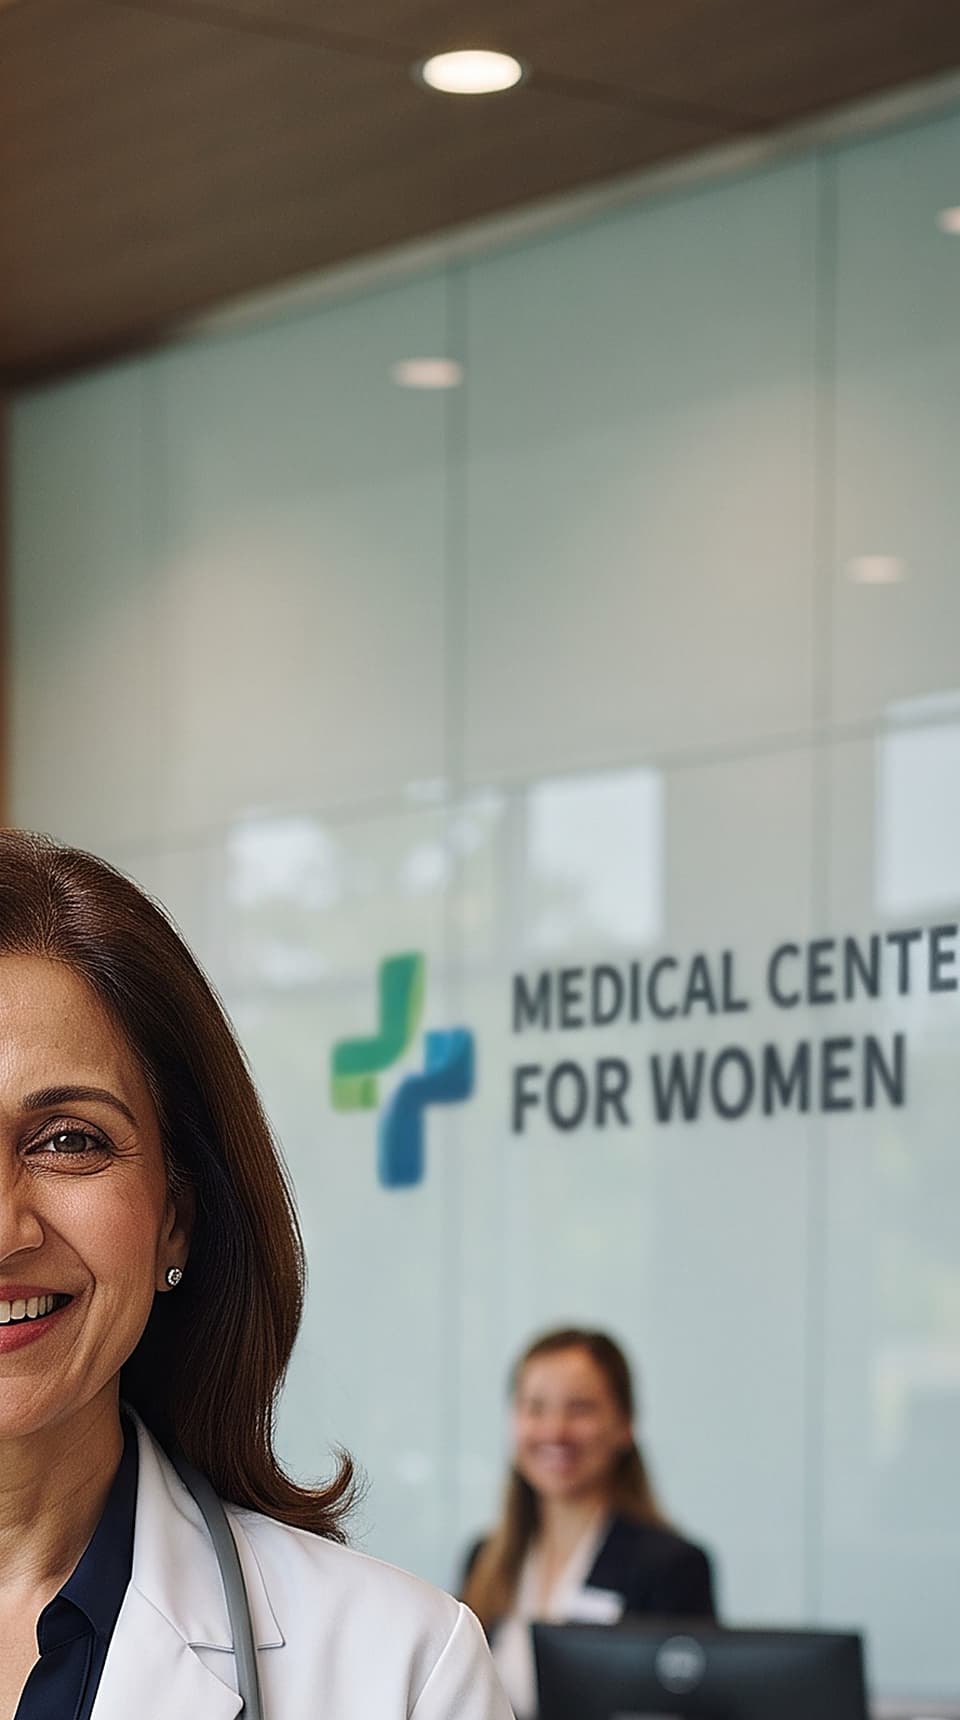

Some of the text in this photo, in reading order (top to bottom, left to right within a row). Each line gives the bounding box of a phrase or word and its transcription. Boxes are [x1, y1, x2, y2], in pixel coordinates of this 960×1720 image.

[512, 923, 958, 1034] MEDICAL CENTE
[511, 1033, 906, 1134] FOR WOMEN
